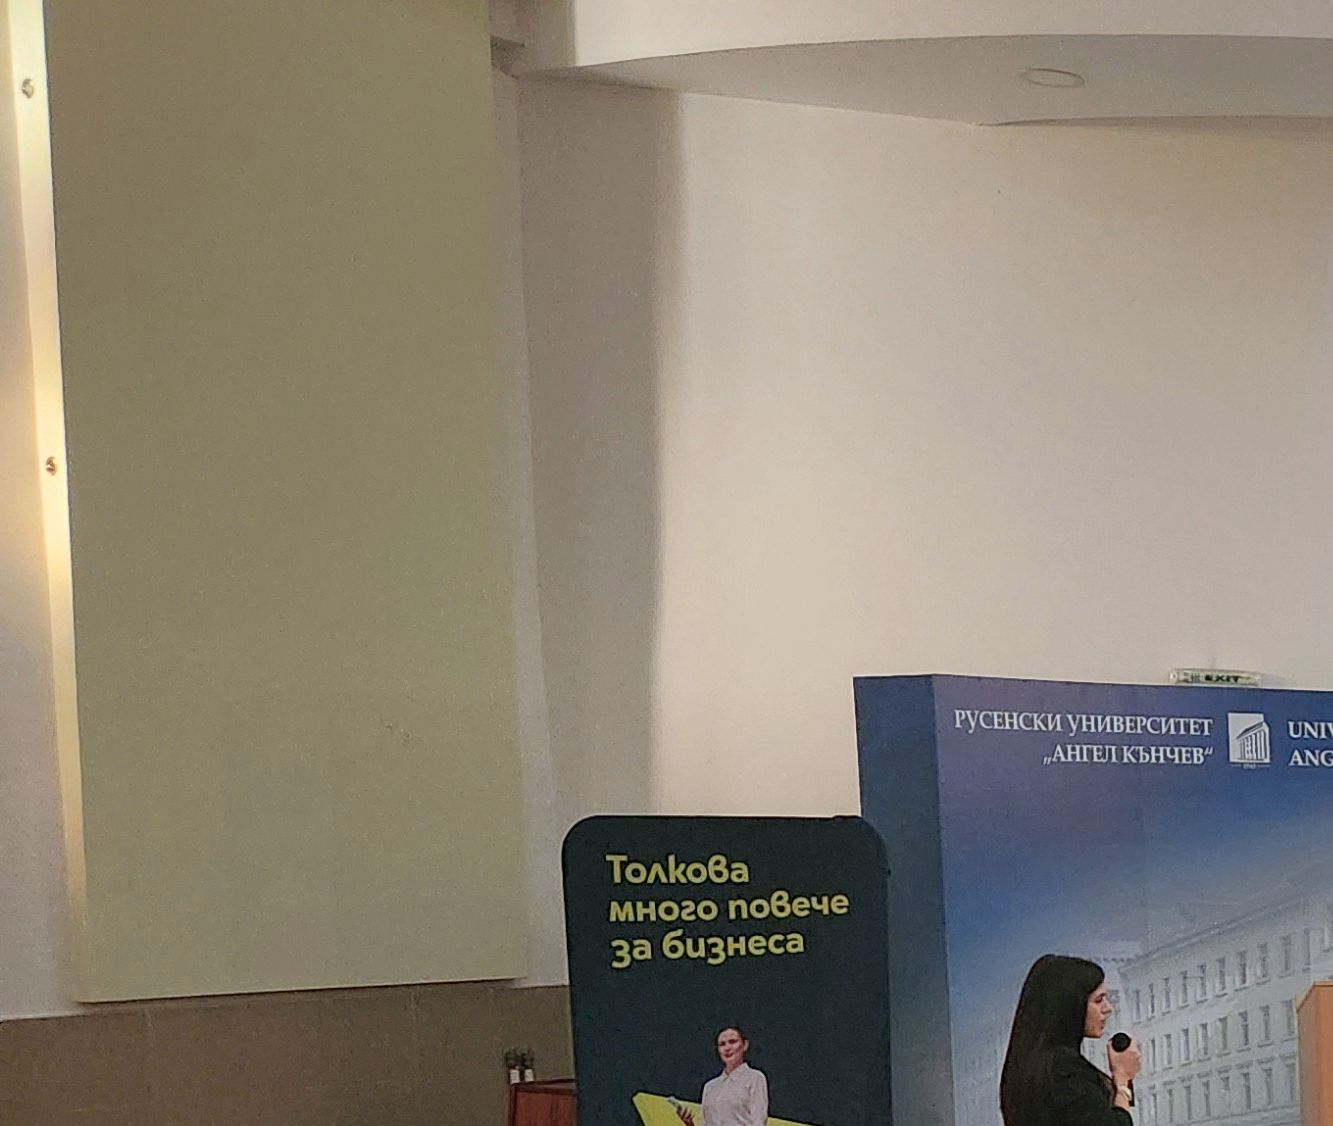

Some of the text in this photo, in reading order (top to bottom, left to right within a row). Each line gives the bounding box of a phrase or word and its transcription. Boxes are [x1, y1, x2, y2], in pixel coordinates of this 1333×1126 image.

[1204, 674, 1244, 684] EXIT
[953, 709, 1213, 737] РУСЕНСКИ УНИВЕРСИТЕТ
[1042, 742, 1116, 765] „АНГЕЛ
[606, 853, 749, 885] Толкова
[608, 890, 850, 924] много повече
[611, 928, 806, 969] за бизнеса
